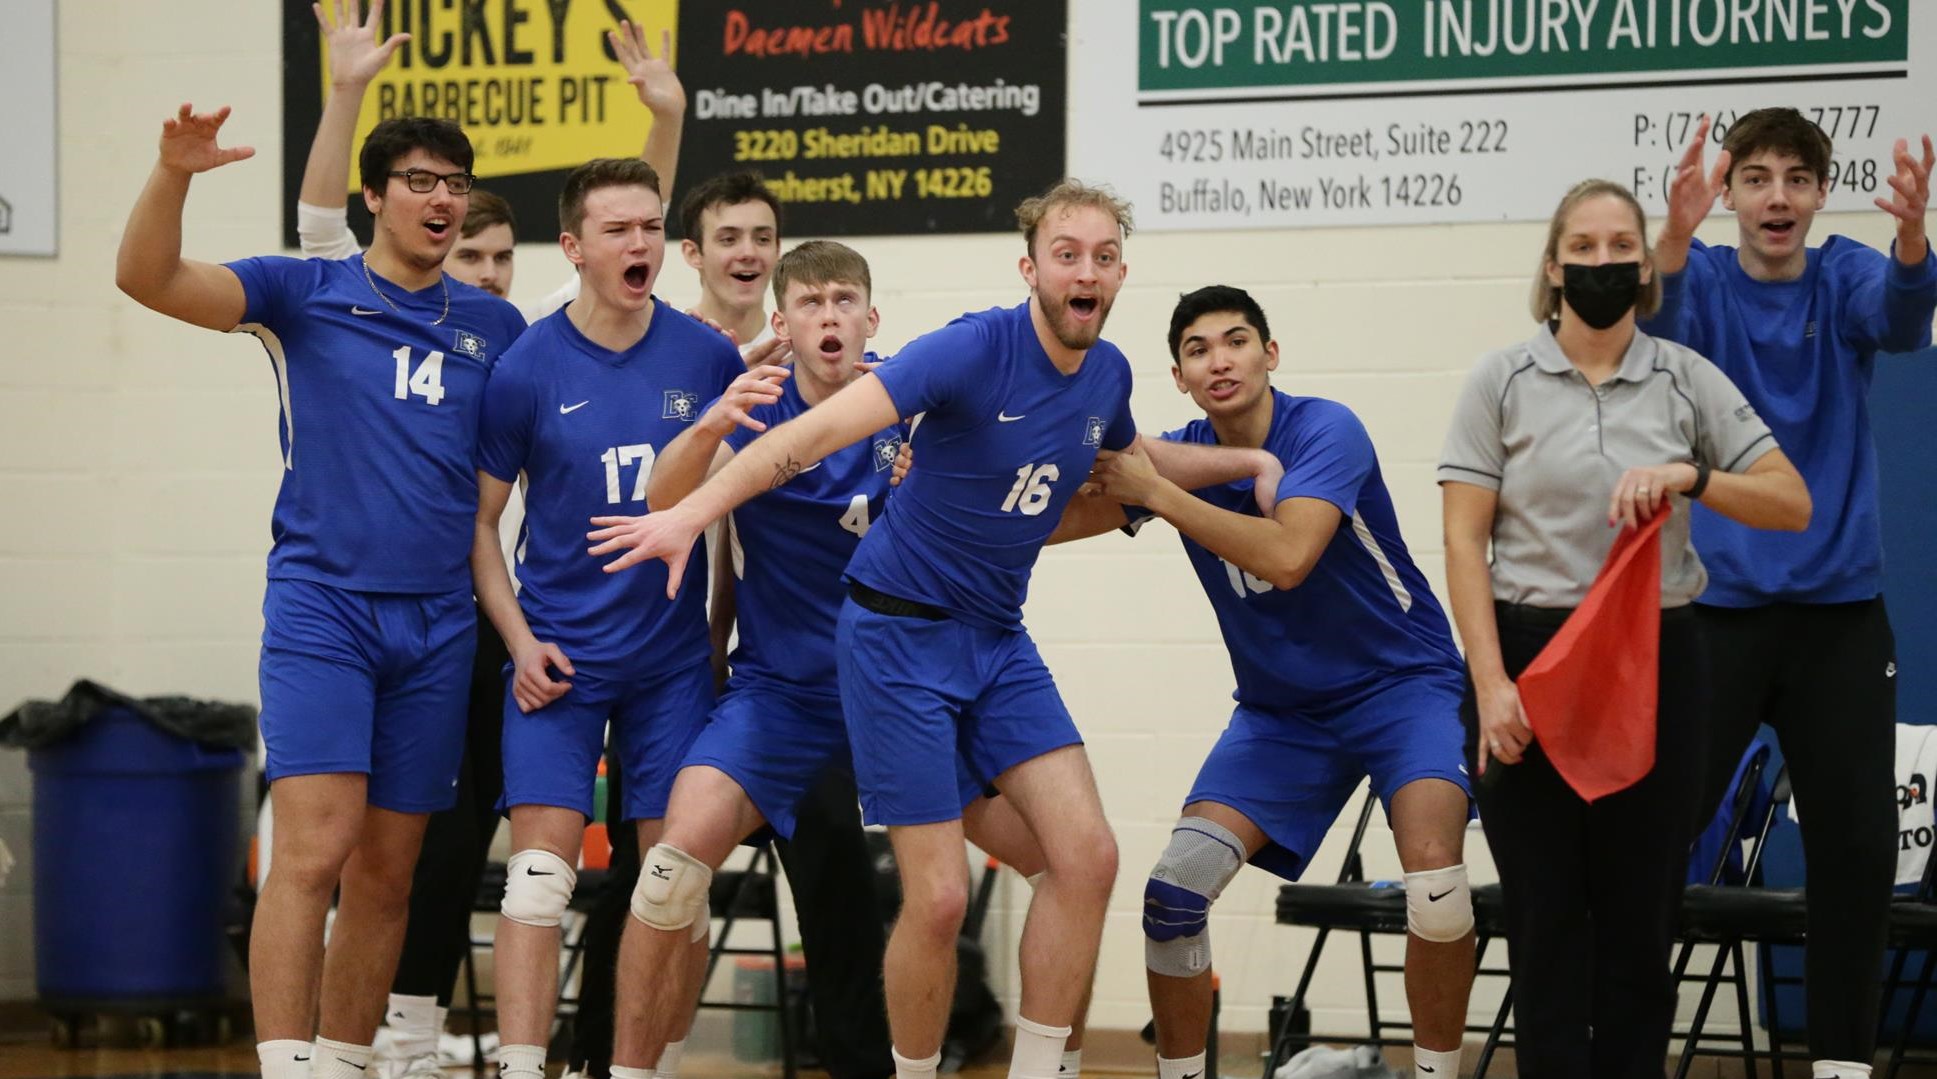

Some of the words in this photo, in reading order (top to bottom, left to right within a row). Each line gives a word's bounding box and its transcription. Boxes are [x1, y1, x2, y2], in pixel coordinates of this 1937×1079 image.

[358, 0, 642, 68] ICKEYS
[724, 10, 853, 57] Daemen
[862, 2, 1011, 50] Wildcats
[1151, 8, 1241, 69] TOP
[1254, 1, 1398, 64] RATED
[1423, 0, 1600, 58] INJURY
[1607, 0, 1892, 50] ATTORNEYS
[378, 78, 543, 126] BARBECUE
[558, 75, 609, 124] PIT
[696, 88, 757, 120] Dine
[762, 84, 857, 117] In/Take
[863, 79, 1040, 116] Out/Catering
[734, 129, 798, 162] 3220
[803, 125, 921, 159] Sheridan
[927, 123, 1000, 155] Drive
[1159, 129, 1223, 162] 4925
[1231, 128, 1292, 160] Main
[1301, 125, 1379, 161] Street,
[1387, 122, 1451, 156] Suite
[1459, 120, 1509, 153] 222
[1635, 113, 1657, 147] P:
[1666, 110, 1737, 152] (76
[763, 171, 861, 204] mherst,
[866, 170, 908, 199] NY
[914, 167, 993, 199] 14226
[1160, 178, 1251, 216] Buffalo,
[1259, 179, 1312, 211] New
[1319, 174, 1372, 209] York
[1381, 173, 1463, 207] 14226
[1633, 166, 1653, 199] F:
[1827, 159, 1877, 193] 948
[392, 345, 446, 406] 14
[600, 443, 657, 504] 17
[1000, 463, 1061, 516] 16
[838, 494, 872, 538] 4
